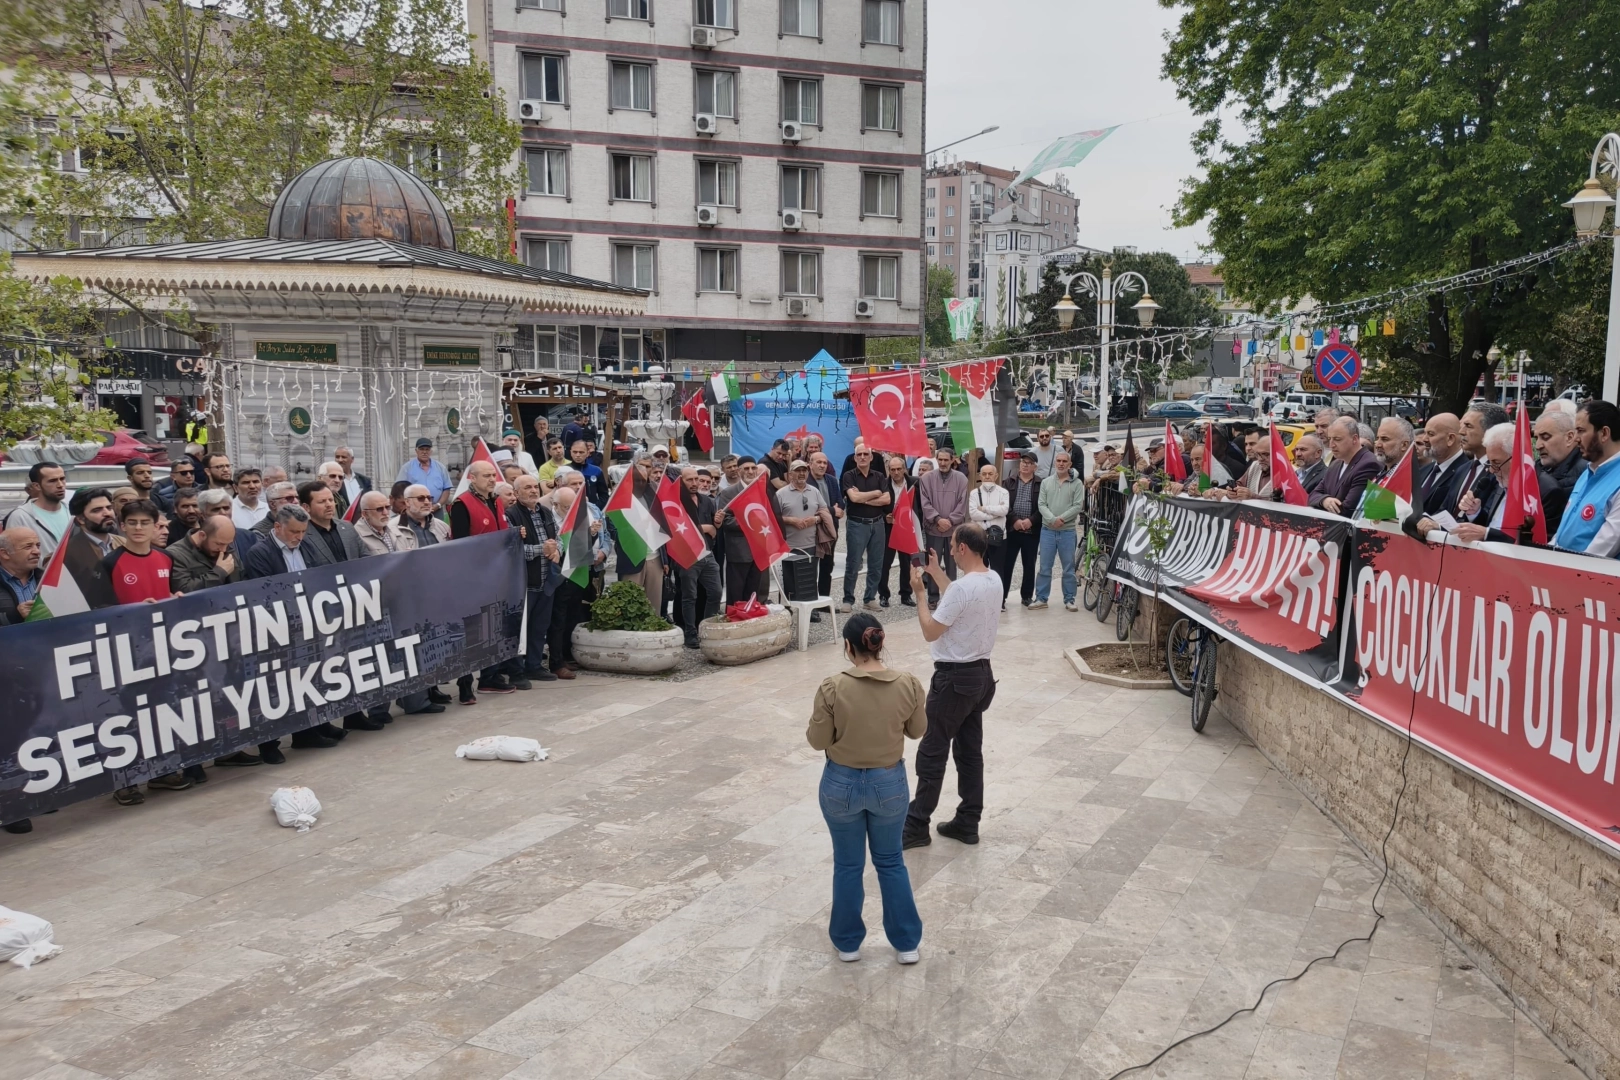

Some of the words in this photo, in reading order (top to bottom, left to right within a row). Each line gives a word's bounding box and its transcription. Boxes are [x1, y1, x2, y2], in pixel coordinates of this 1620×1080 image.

[54, 595, 290, 700] FİLİSTİN
[294, 574, 382, 647] İÇİN
[1204, 522, 1339, 638] HAYIR!
[1356, 565, 1514, 735] ÇOCUKLAR
[18, 678, 216, 794] SESİNİ
[222, 633, 421, 731] YÜKSELT
